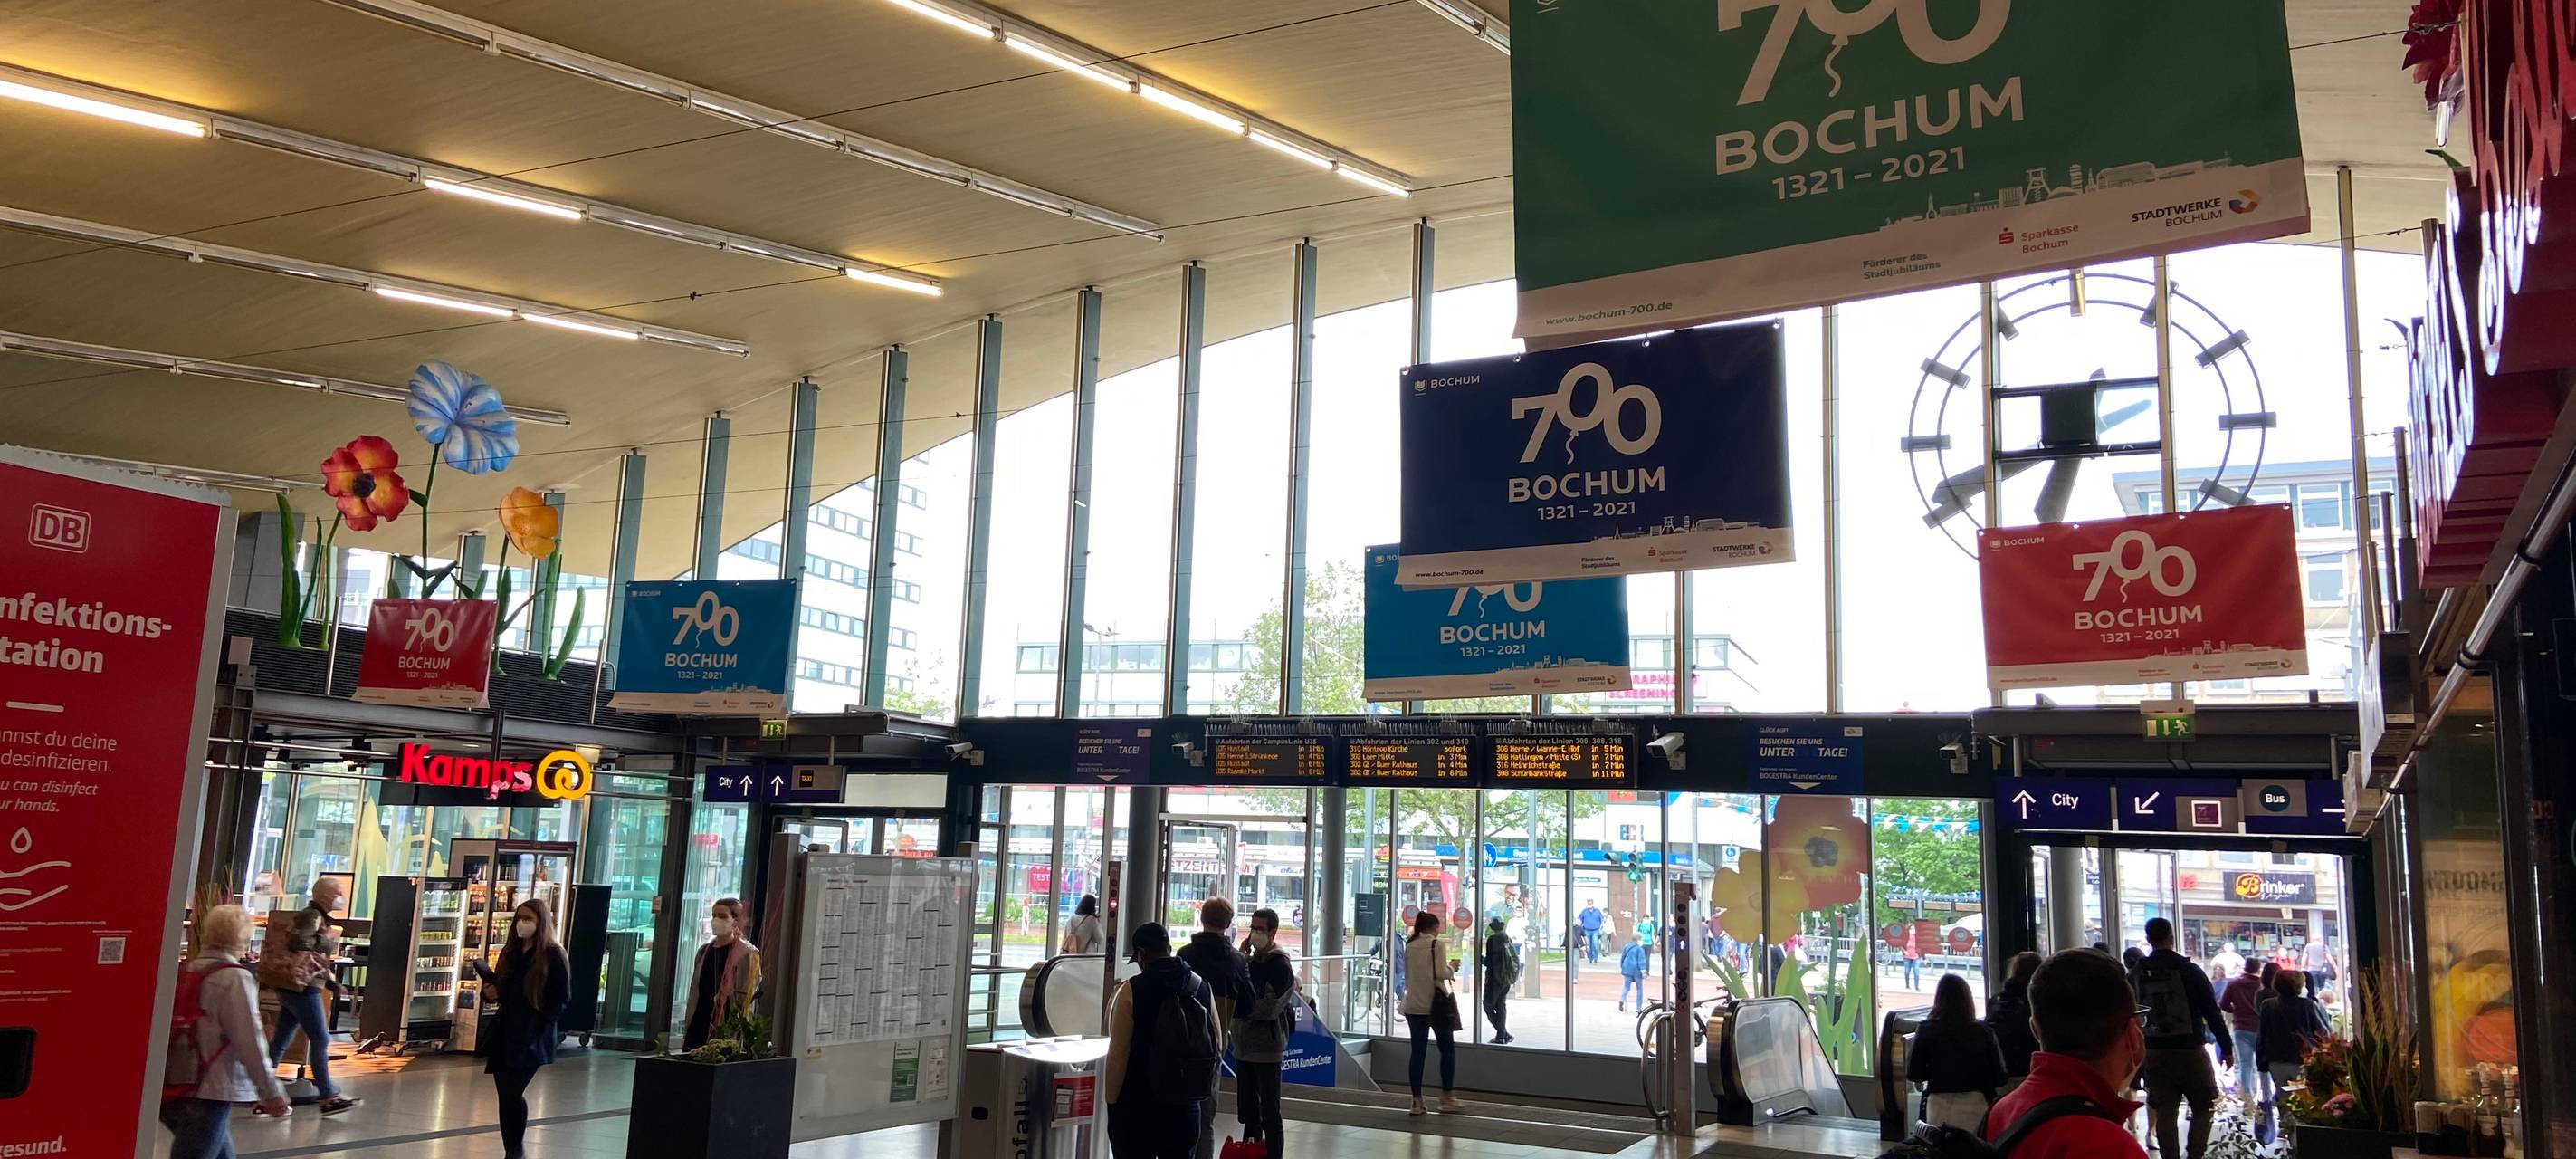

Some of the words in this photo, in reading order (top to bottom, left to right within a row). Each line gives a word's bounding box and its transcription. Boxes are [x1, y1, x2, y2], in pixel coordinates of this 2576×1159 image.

[1717, 0, 2011, 106] 70
[1715, 75, 2024, 175] BOCHUM
[1772, 167, 1845, 200] 1321
[1881, 146, 1965, 182] 2021
[2131, 197, 2221, 223] STADTWERKE
[2165, 209, 2223, 227] BOCHUM
[2020, 223, 2079, 243] Sparkasse
[2021, 237, 2069, 254] Bochum
[1863, 254, 1908, 268] Förderer
[1910, 252, 1928, 263] des
[1863, 260, 1941, 281] Stadtjubiläums
[1545, 302, 1673, 325] www.bochum-700.de
[1430, 375, 1480, 388] BOCHUM
[1512, 362, 1662, 463] 700
[1508, 466, 1665, 503] BOCHUM
[1538, 504, 1575, 521] 1321
[1593, 501, 1636, 517] 2021
[37, 511, 83, 545] DB
[1713, 543, 1756, 552] STADTWERKE
[2004, 536, 2045, 546] BOCHUM
[1415, 569, 1484, 578] www.bochum-700.de
[2073, 530, 2198, 602] 700
[1447, 581, 1543, 616] 70
[673, 590, 739, 647] 700
[2074, 604, 2203, 630] BOCHUM
[405, 608, 454, 652] 700
[1439, 620, 1546, 646] BOCHUM
[2100, 631, 2132, 644] 1321
[2144, 629, 2180, 640] 2021
[1460, 646, 1485, 657] 1321
[1497, 644, 1526, 656] 2021
[398, 656, 450, 670] BOCHUM
[664, 653, 738, 668] BOCHUM
[678, 671, 695, 679] 1321
[702, 671, 723, 679] 2021
[0, 730, 41, 745] nnst
[45, 730, 67, 747] du
[72, 733, 117, 752] deine
[0, 749, 112, 772] desinfizieren.
[1760, 748, 1795, 757] UNTER
[1818, 748, 1848, 757] TAGE!
[400, 742, 533, 800] Kamps
[13, 781, 38, 791] can
[41, 780, 99, 797] disinfect
[719, 777, 733, 788] City
[14, 798, 60, 812] hands.
[2052, 793, 2079, 808] City
[2265, 793, 2285, 803] Bus
[2237, 876, 2301, 895] Brinker
[1293, 1007, 1302, 1021] E!
[1300, 1055, 1332, 1068] KundenCenter
